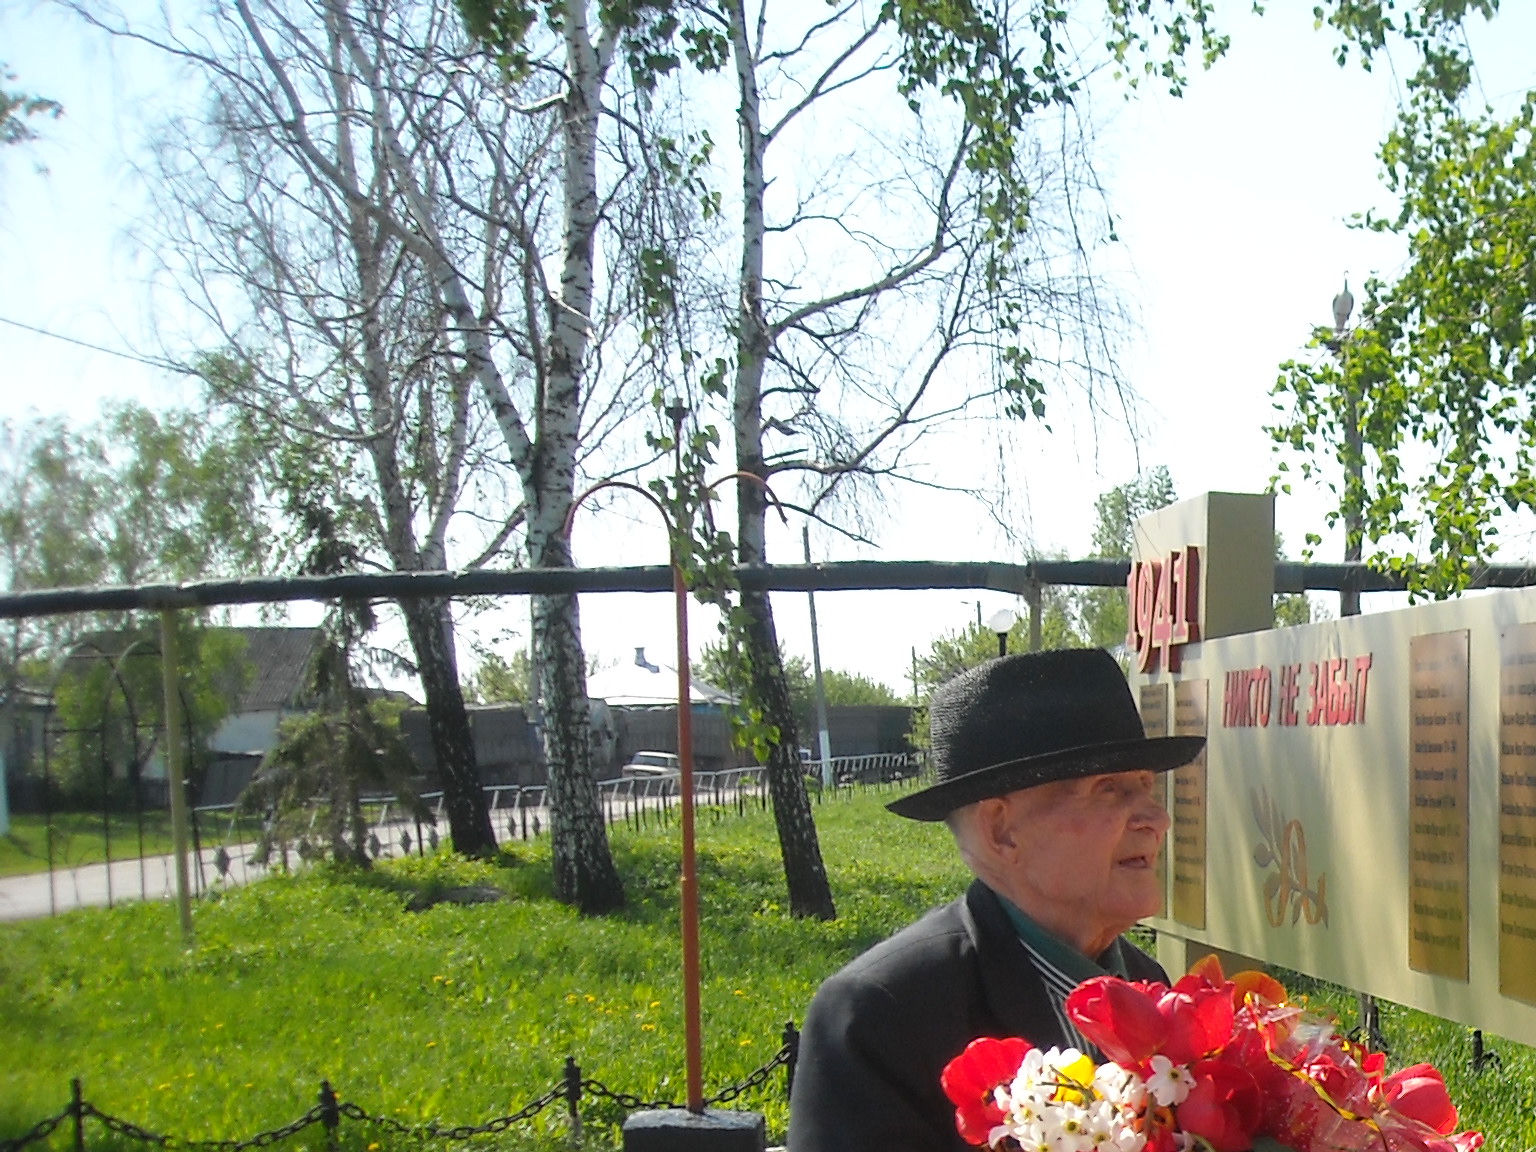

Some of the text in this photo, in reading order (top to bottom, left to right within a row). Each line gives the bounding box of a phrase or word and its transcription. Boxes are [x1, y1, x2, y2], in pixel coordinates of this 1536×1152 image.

[1126, 545, 1200, 674] 1941
[1222, 664, 1272, 728] НИКТО
[1278, 661, 1302, 726] НЕ
[1306, 652, 1373, 726] ЗАБЫТ
